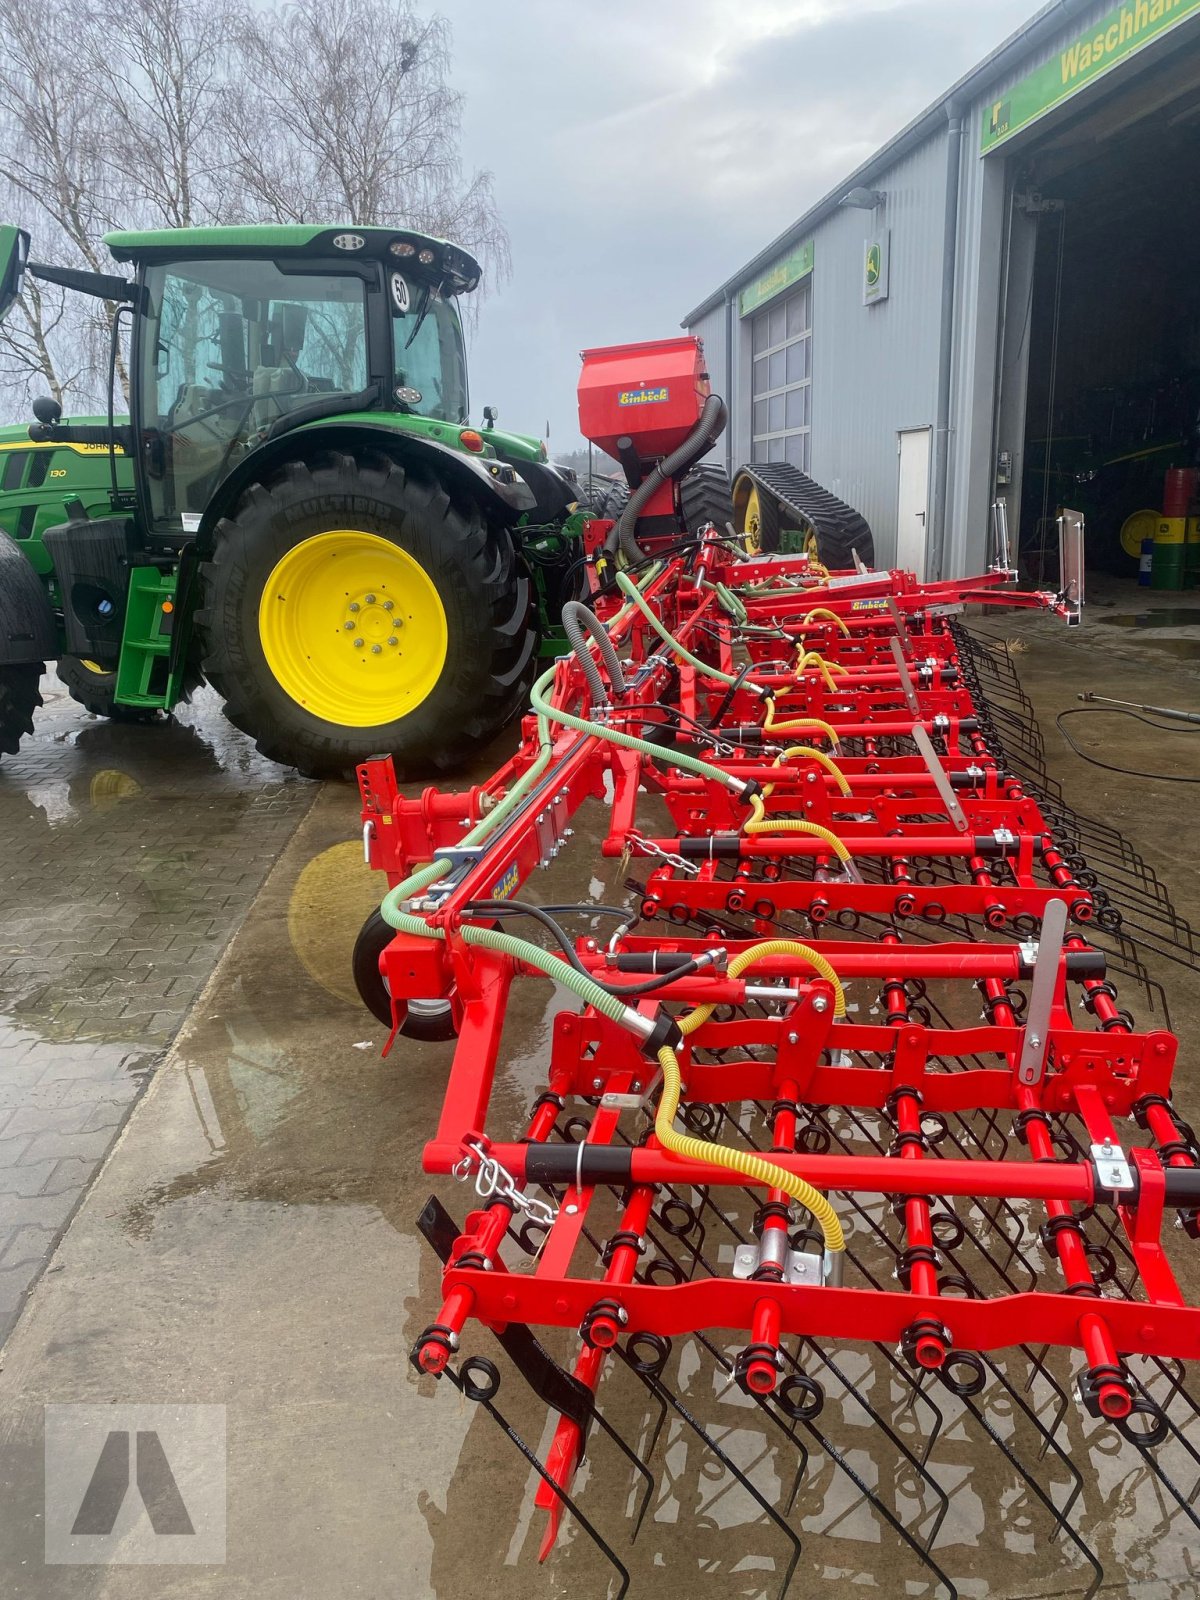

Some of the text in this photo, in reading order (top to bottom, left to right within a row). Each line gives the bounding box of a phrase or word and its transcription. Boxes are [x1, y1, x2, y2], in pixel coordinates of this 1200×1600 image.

[1060, 0, 1180, 84] Waschha
[395, 278, 407, 305] 50
[620, 389, 667, 404] Einböck
[50, 469, 66, 477] 130
[853, 600, 889, 610] Einböck
